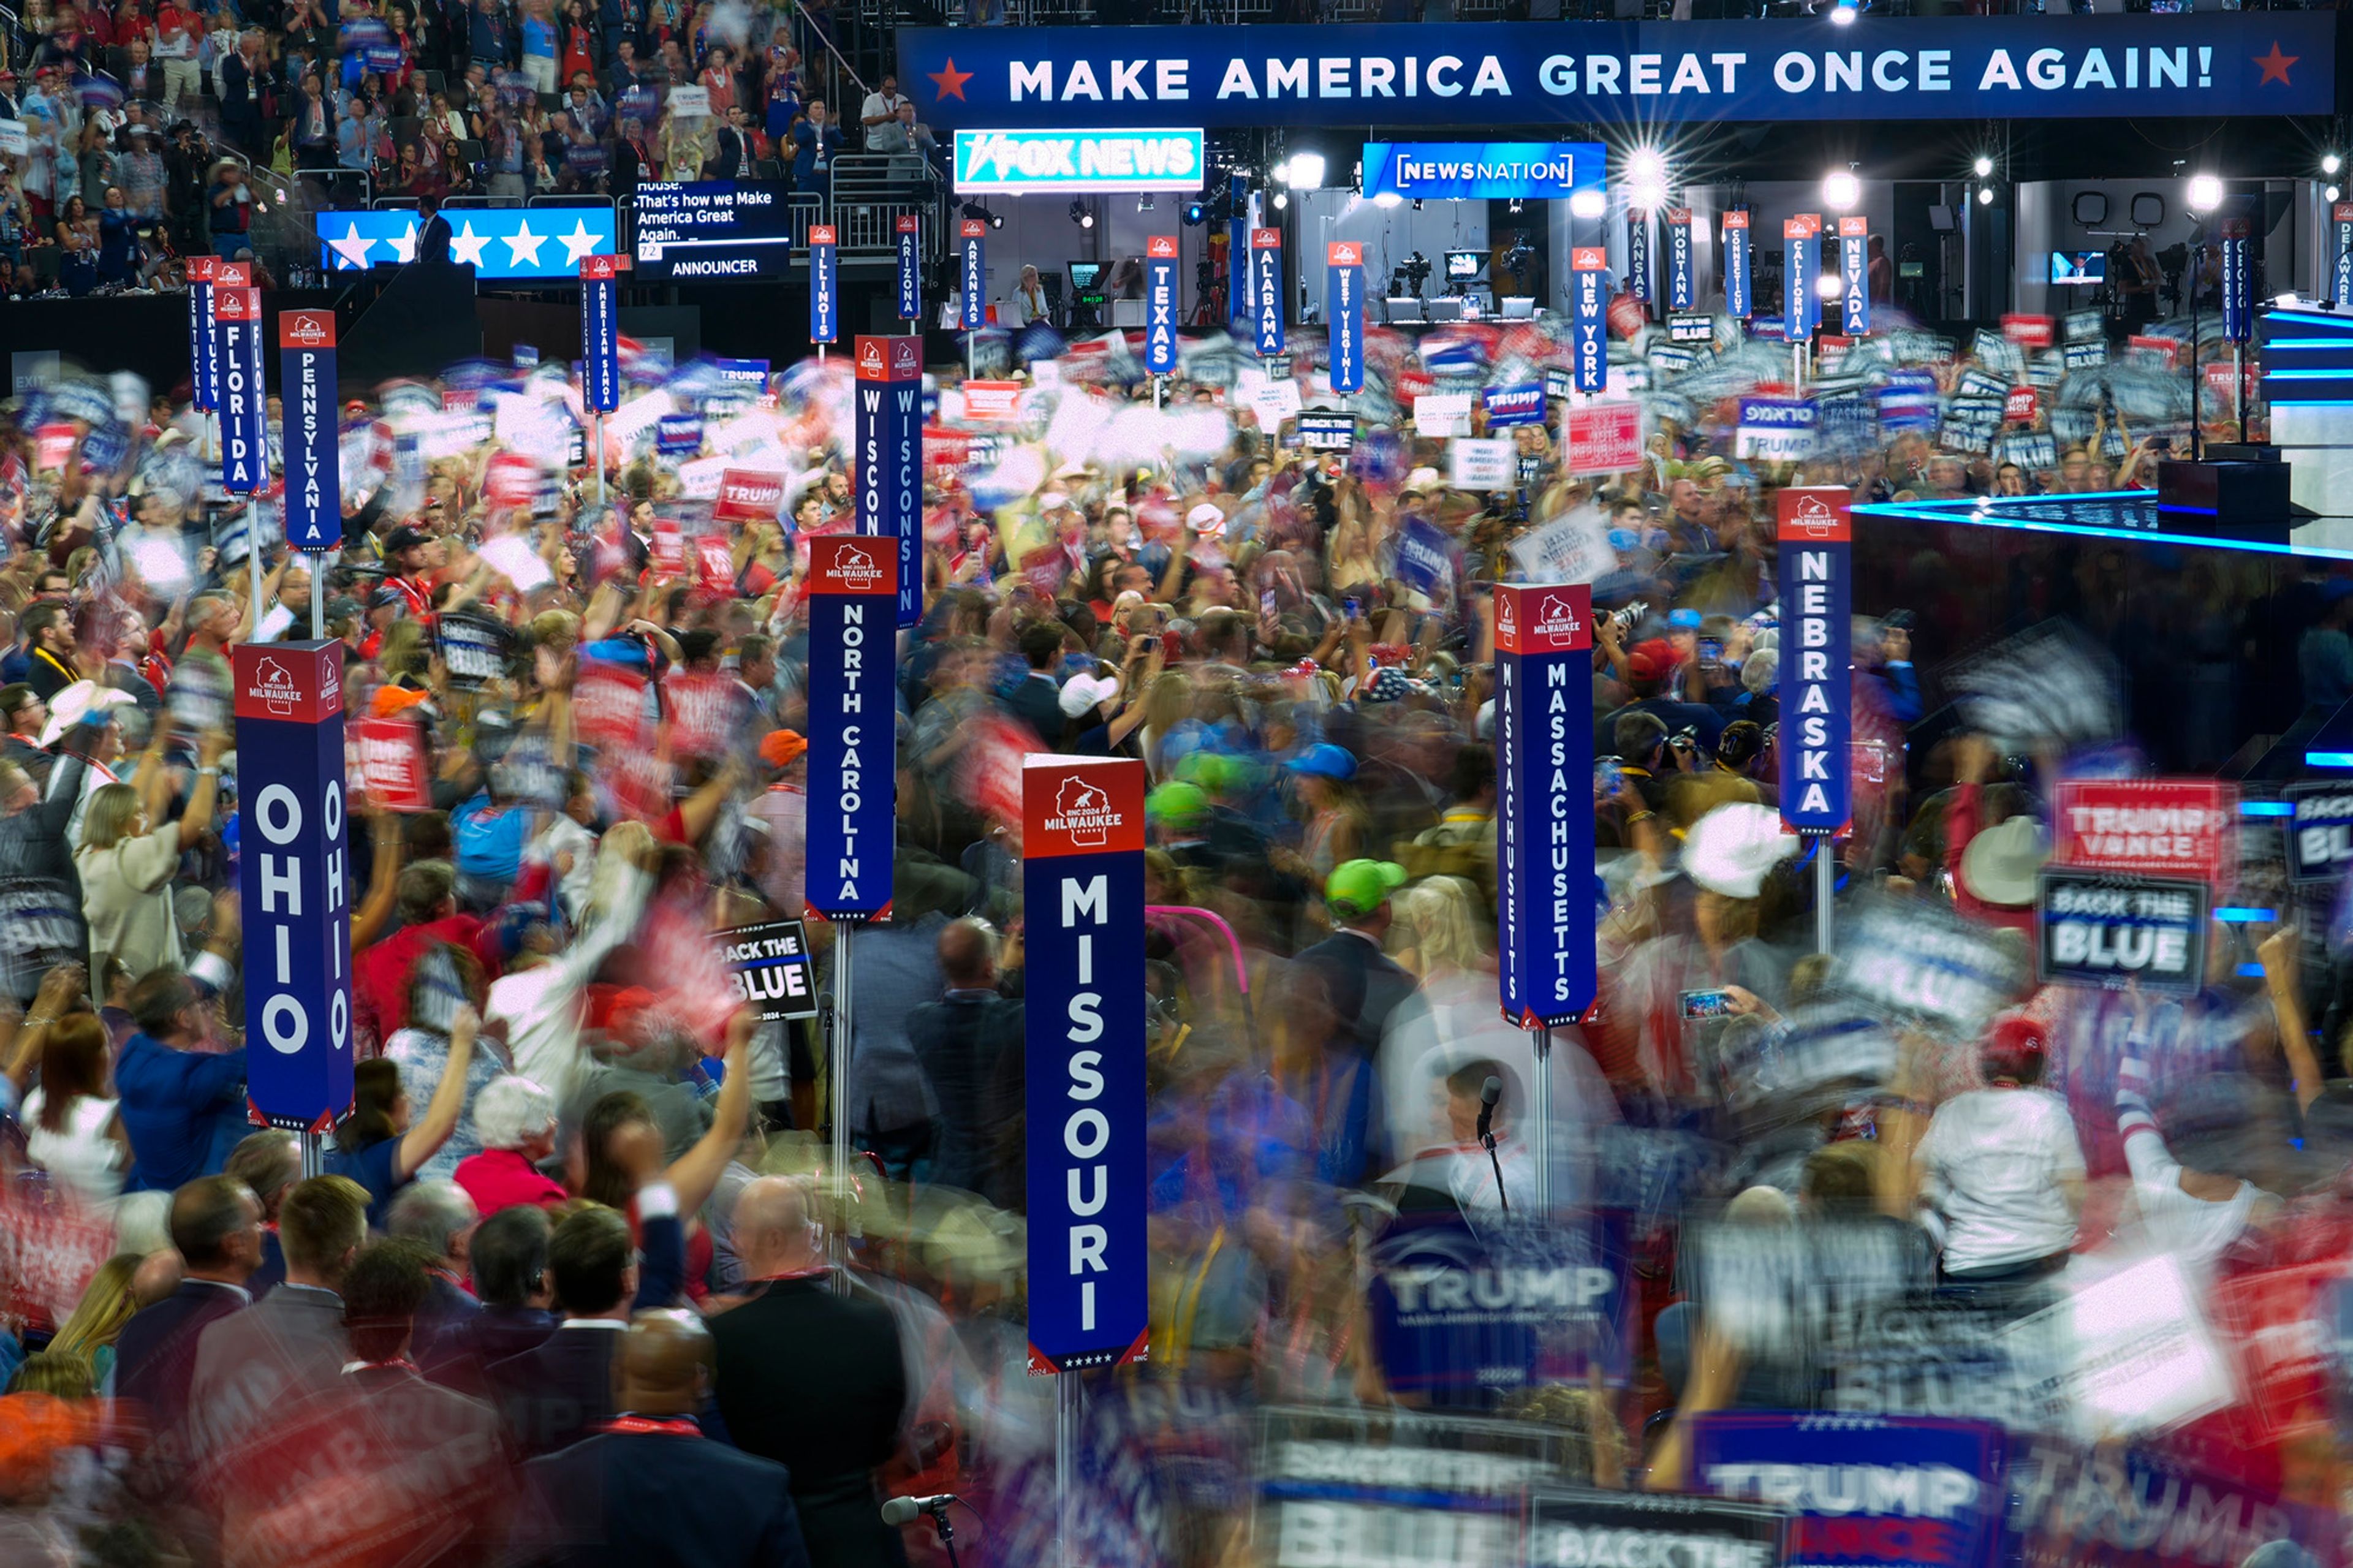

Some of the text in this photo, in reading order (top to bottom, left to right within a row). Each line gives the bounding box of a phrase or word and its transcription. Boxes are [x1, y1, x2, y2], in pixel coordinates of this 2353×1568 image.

[1009, 45, 2215, 102] MAKE AMERICA GREAT ONCE AGAIN!
[996, 135, 1195, 180] FOX NEWS
[638, 209, 735, 225] America Great
[683, 193, 711, 207] how
[714, 195, 733, 206] we
[737, 191, 772, 205] Make
[638, 228, 681, 243] Again.
[641, 246, 657, 257] 72
[673, 259, 758, 276] ANNOUNCER
[902, 235, 913, 312] ARIZONA
[968, 240, 978, 323] ARKANSAS
[1633, 224, 1645, 298] KANSAS
[1675, 227, 1687, 305] MONTANA
[1732, 229, 1743, 314] CONNECTICUT
[1847, 239, 1863, 328] NEVADA
[818, 247, 829, 336] ILLINOIS
[1260, 250, 1277, 348] ALABAMA
[1793, 241, 1803, 335] CALIFORNIA
[2223, 240, 2232, 337] GEORGIA
[1152, 266, 1170, 364] TEXAS
[1339, 268, 1352, 387] WEST VIRGINIA
[1580, 273, 1599, 386] NEW YORK
[1672, 327, 1711, 339] BLUE
[190, 284, 200, 403] KENTUCKY
[206, 284, 218, 403] KENTUCKY
[599, 282, 610, 405] AMERICAN SAMOA
[1822, 344, 1849, 354] TRU
[2067, 354, 2106, 368] BLUE
[16, 375, 46, 389] EXIT
[720, 370, 765, 382] TRUMP
[1486, 390, 1541, 407] TRUMP
[2007, 395, 2034, 404] UMP
[2209, 373, 2252, 382] TRUP
[227, 326, 249, 482] FLORIDA
[253, 325, 267, 480] FLORIDA
[302, 352, 322, 539] PENNSYLVANIA
[863, 389, 881, 536] WISCON
[1304, 431, 1351, 448] BLUE
[1745, 436, 1811, 453] TRUMP
[727, 485, 781, 502] TRUMP
[897, 389, 914, 612] WISCONSIN
[1534, 622, 1580, 635] MILWAUKEE
[249, 687, 302, 702] MILWAUKEE
[1800, 551, 1830, 813] NEBRASKA
[838, 604, 864, 901] NORTH CAROLINA
[1044, 813, 1122, 831] MILWAUKEE
[1502, 662, 1517, 1001] MASSACHUSETTS
[1547, 662, 1578, 1002] MASSACHUSETTS
[2067, 802, 2227, 834] TRUMP
[2082, 835, 2195, 857] VANCE
[2300, 825, 2353, 865] BL
[255, 782, 309, 1055] OHIO
[325, 779, 347, 1050] OHIO
[2053, 886, 2191, 921] BACK THE
[714, 936, 799, 963] BACK THE
[2054, 922, 2188, 972] BLUE
[726, 963, 807, 1005] BLUE
[762, 1012, 780, 1021] 2024
[1061, 874, 1110, 1332] MISSOURI
[1389, 1267, 1618, 1313] TRUMP
[1028, 1368, 1047, 1376] 2024
[1708, 1462, 1980, 1518] TRUMP
[1550, 1524, 1674, 1568] BACK
